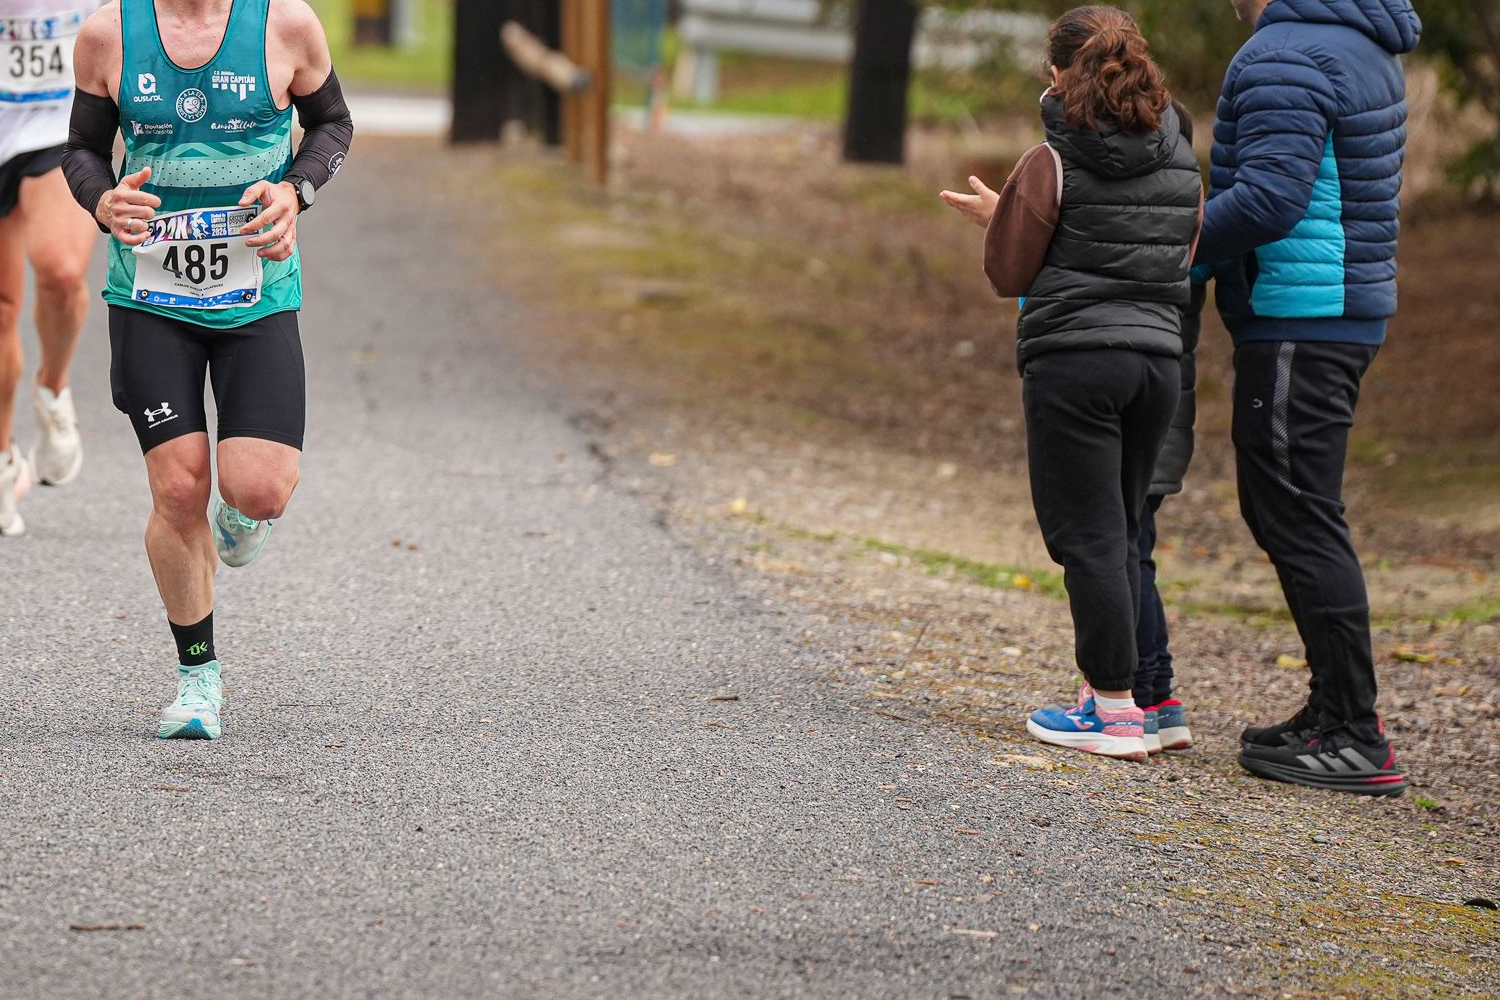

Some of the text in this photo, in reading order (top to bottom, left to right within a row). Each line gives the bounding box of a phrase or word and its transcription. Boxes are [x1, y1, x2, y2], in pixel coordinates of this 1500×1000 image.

[9, 45, 64, 78] 354
[211, 74, 256, 83] GRAN CAPITÁN
[211, 227, 227, 236] 2026
[162, 242, 229, 285] 485
